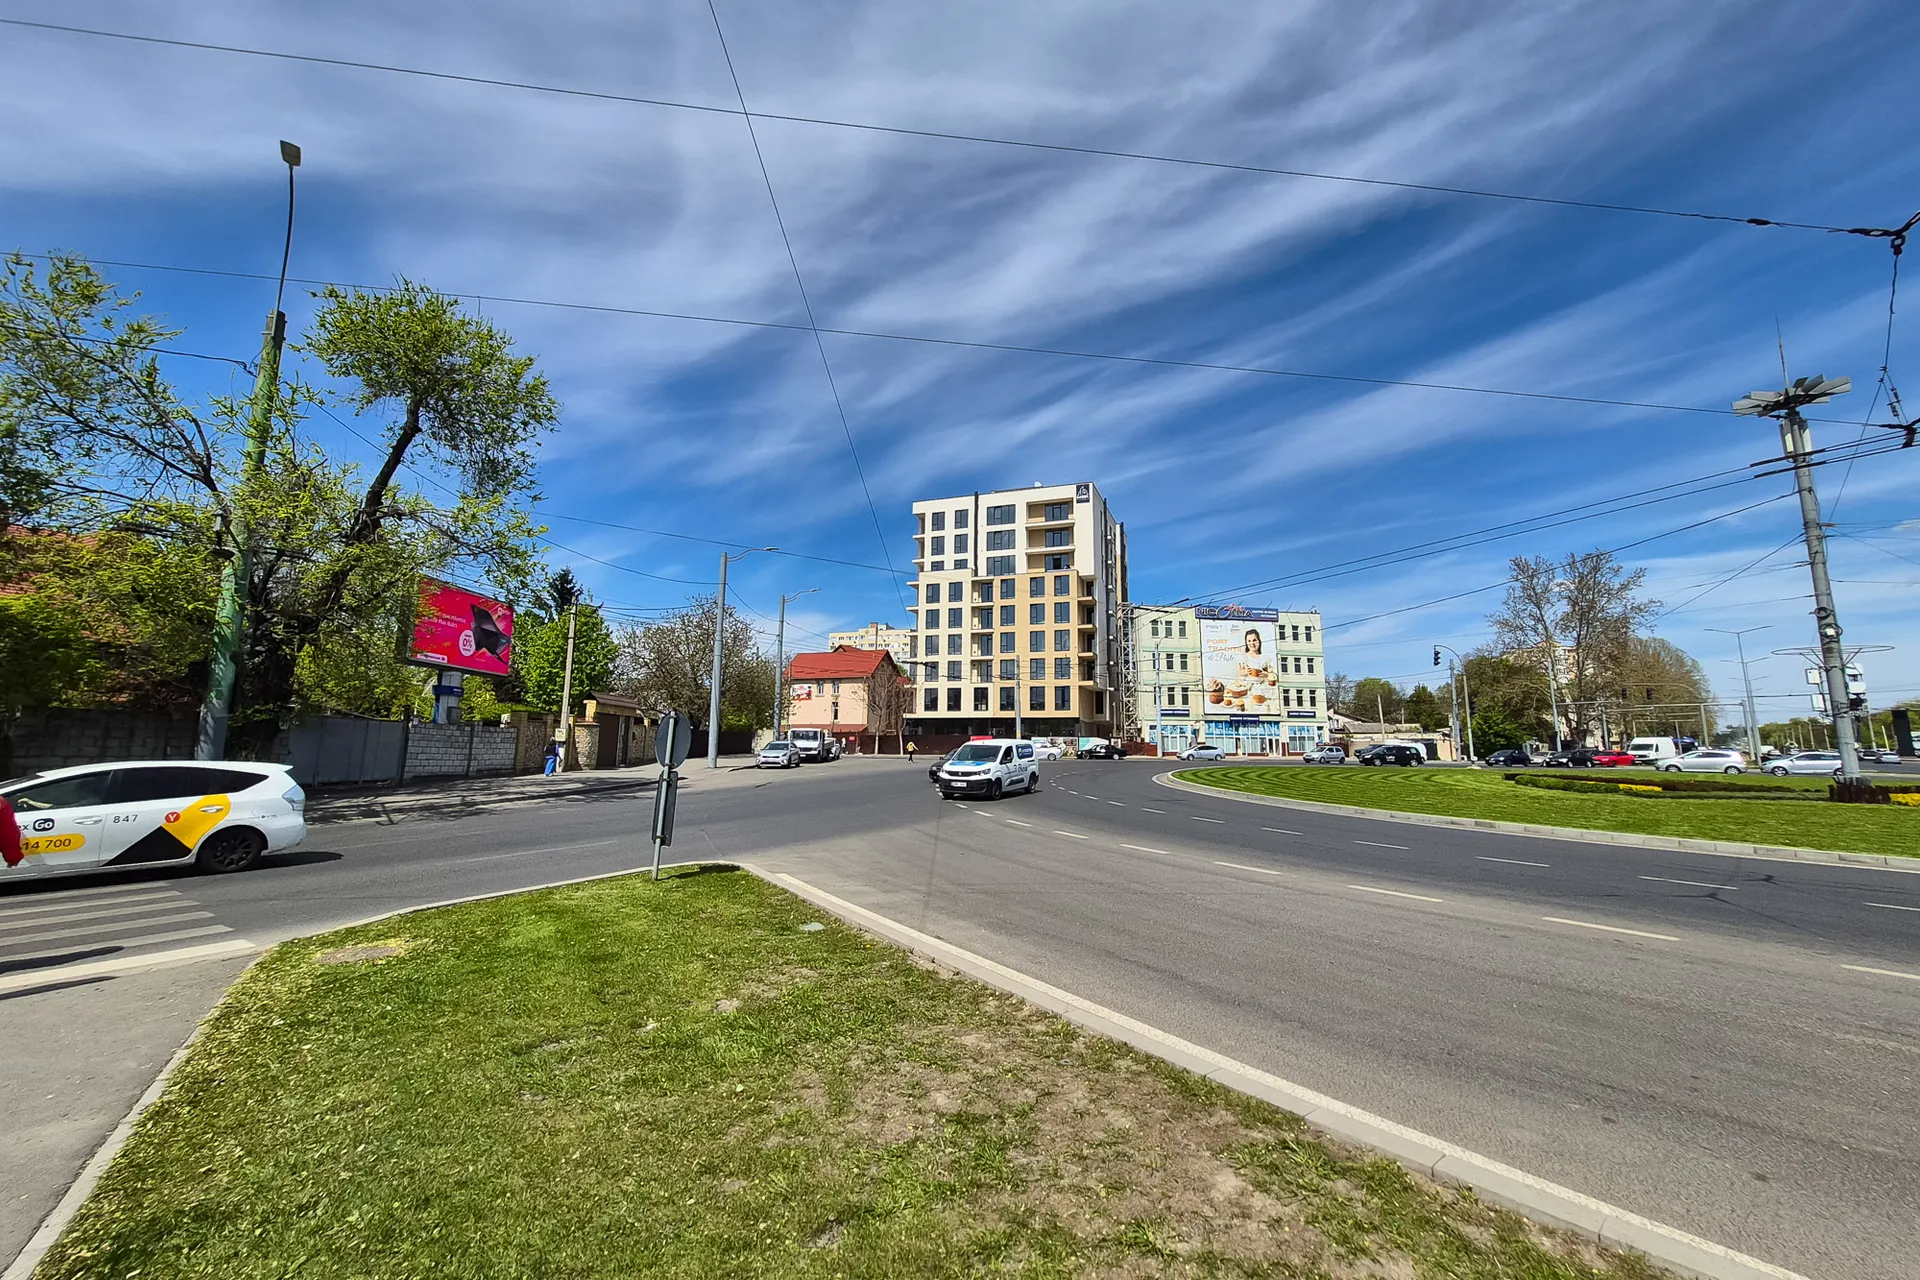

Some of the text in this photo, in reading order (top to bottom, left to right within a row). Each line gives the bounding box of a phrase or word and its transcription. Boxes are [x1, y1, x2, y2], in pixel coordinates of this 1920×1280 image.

[113, 815, 138, 823] 847
[34, 820, 54, 830] Go
[45, 838, 72, 849] 700
